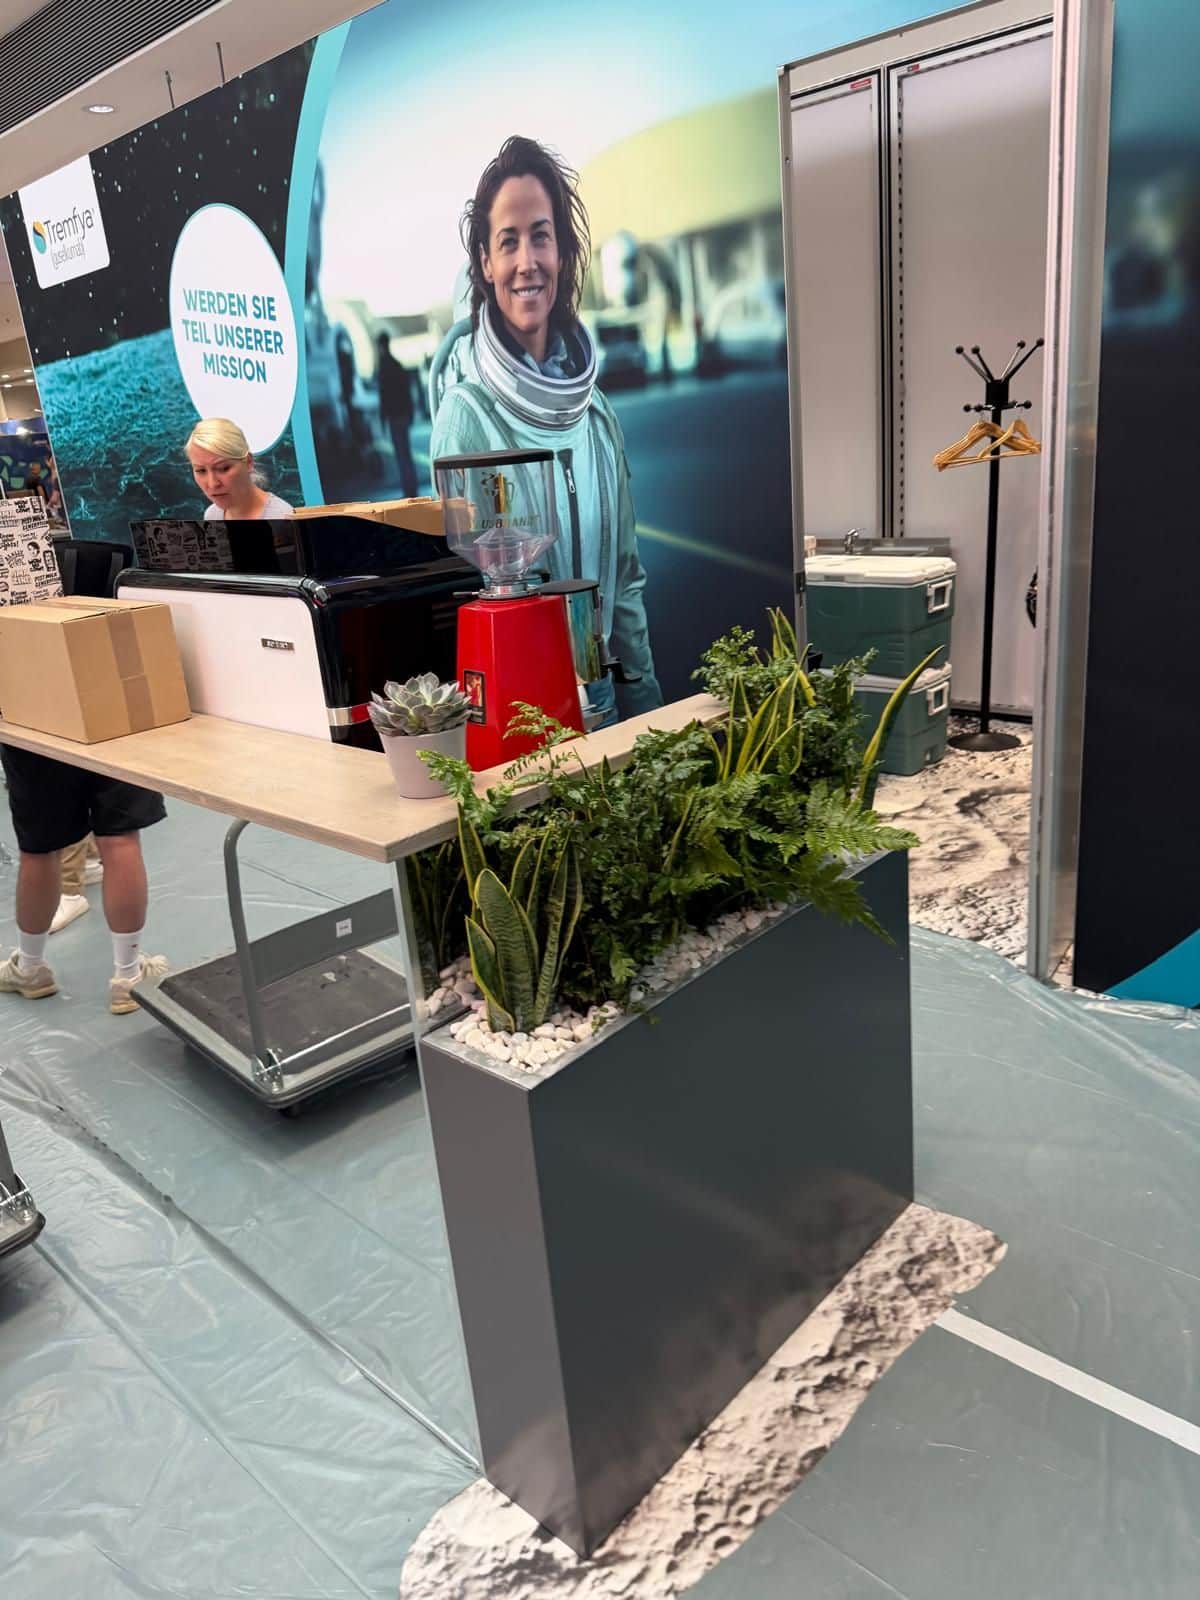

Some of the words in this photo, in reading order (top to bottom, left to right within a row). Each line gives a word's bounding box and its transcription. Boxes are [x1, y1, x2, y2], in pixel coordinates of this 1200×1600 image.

[44, 206, 94, 243] Tremfya
[183, 288, 248, 318] WERDEN
[252, 296, 277, 321] SIE
[182, 319, 212, 346] TEIL
[214, 326, 284, 355] UNSERER
[203, 352, 268, 384] MISSION
